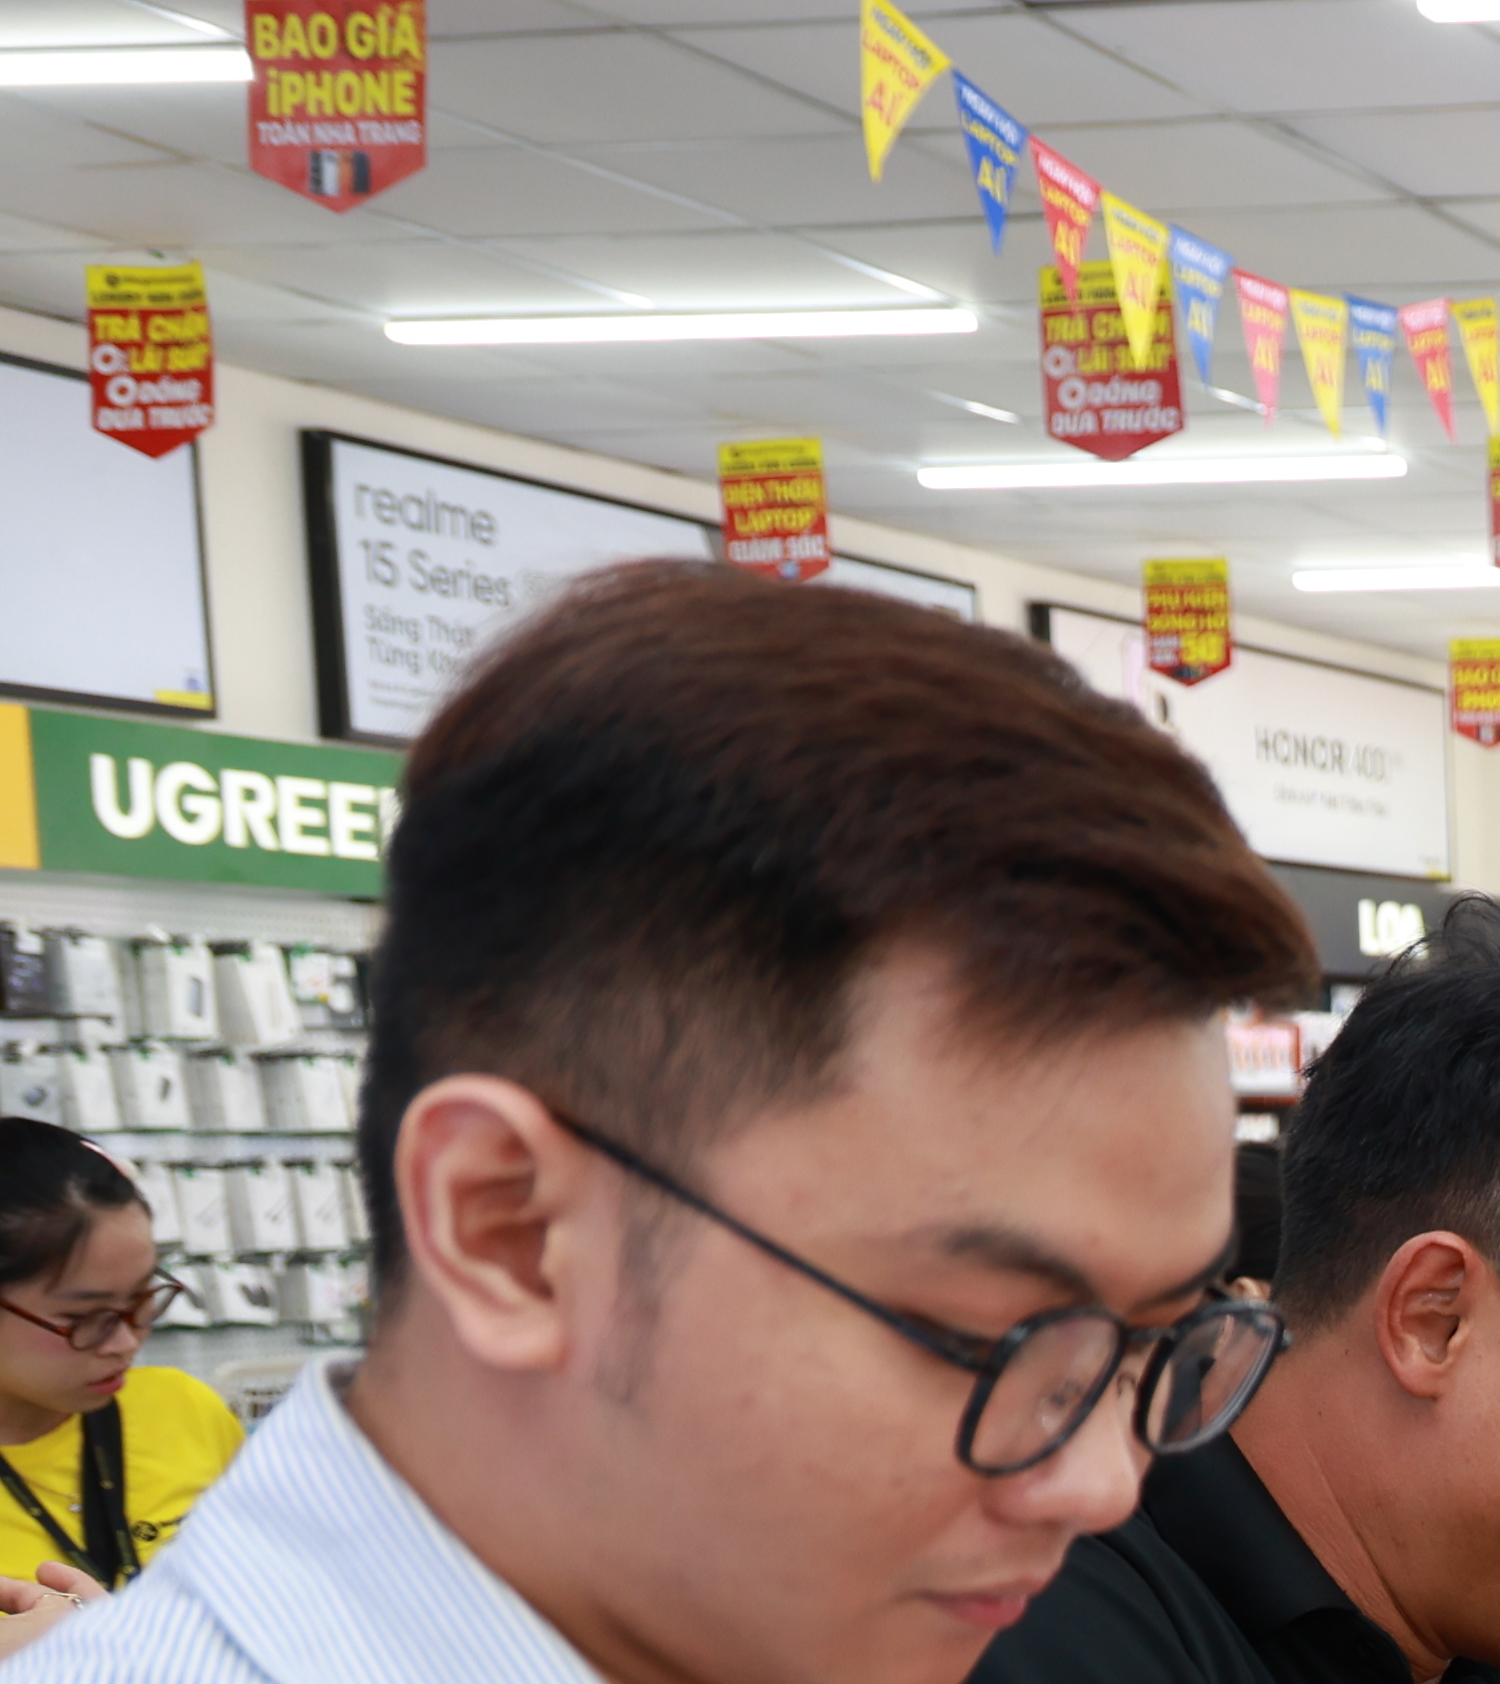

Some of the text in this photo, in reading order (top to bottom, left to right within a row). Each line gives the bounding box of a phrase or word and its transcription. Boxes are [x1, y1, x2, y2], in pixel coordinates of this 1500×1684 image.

[253, 12, 338, 59] BAO
[266, 68, 416, 116] iPHONE
[354, 482, 496, 546] realme
[359, 538, 398, 588] 15
[408, 548, 510, 606] Series
[1255, 726, 1345, 775] HONOR
